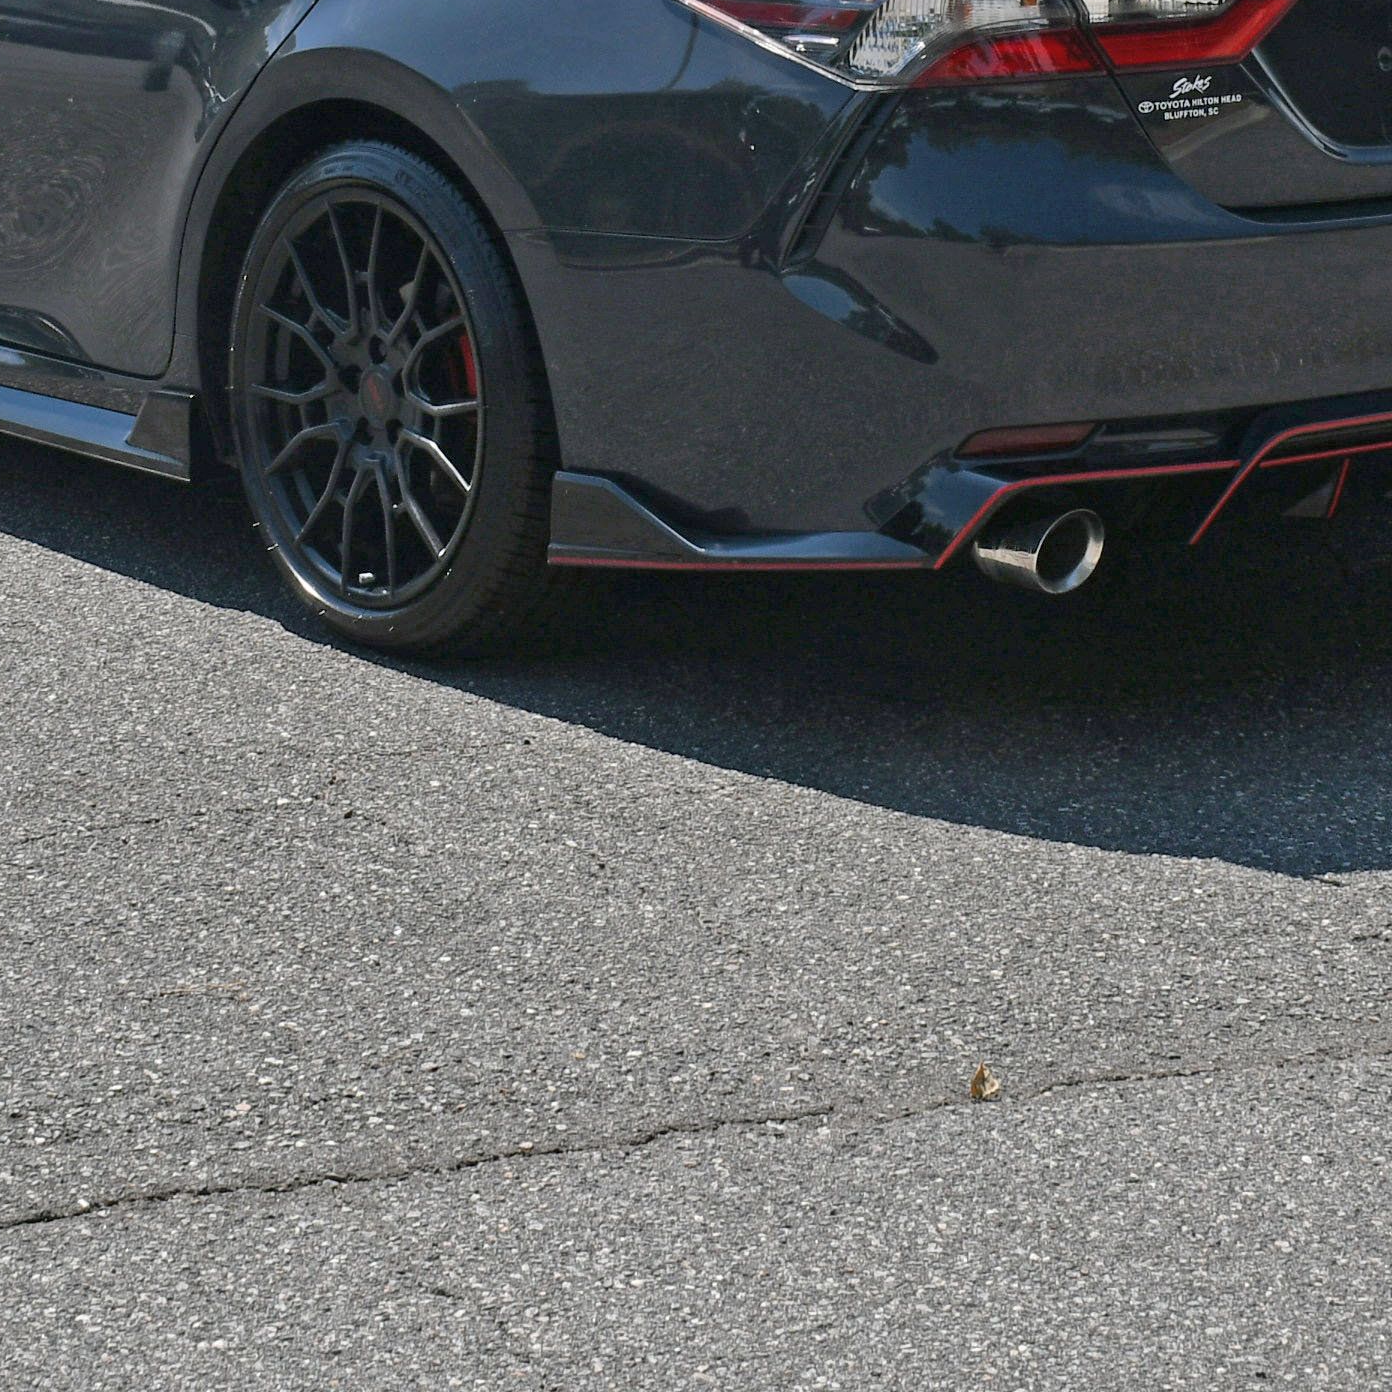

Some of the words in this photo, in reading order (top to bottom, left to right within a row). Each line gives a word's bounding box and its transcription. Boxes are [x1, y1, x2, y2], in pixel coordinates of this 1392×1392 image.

[1169, 74, 1212, 99] Stokes
[1154, 100, 1190, 110] TOYOTA
[1192, 97, 1219, 106] HILTON
[1220, 94, 1242, 104] HEAD
[1164, 110, 1207, 120] BLUFFTON,
[1208, 107, 1219, 116] SC
